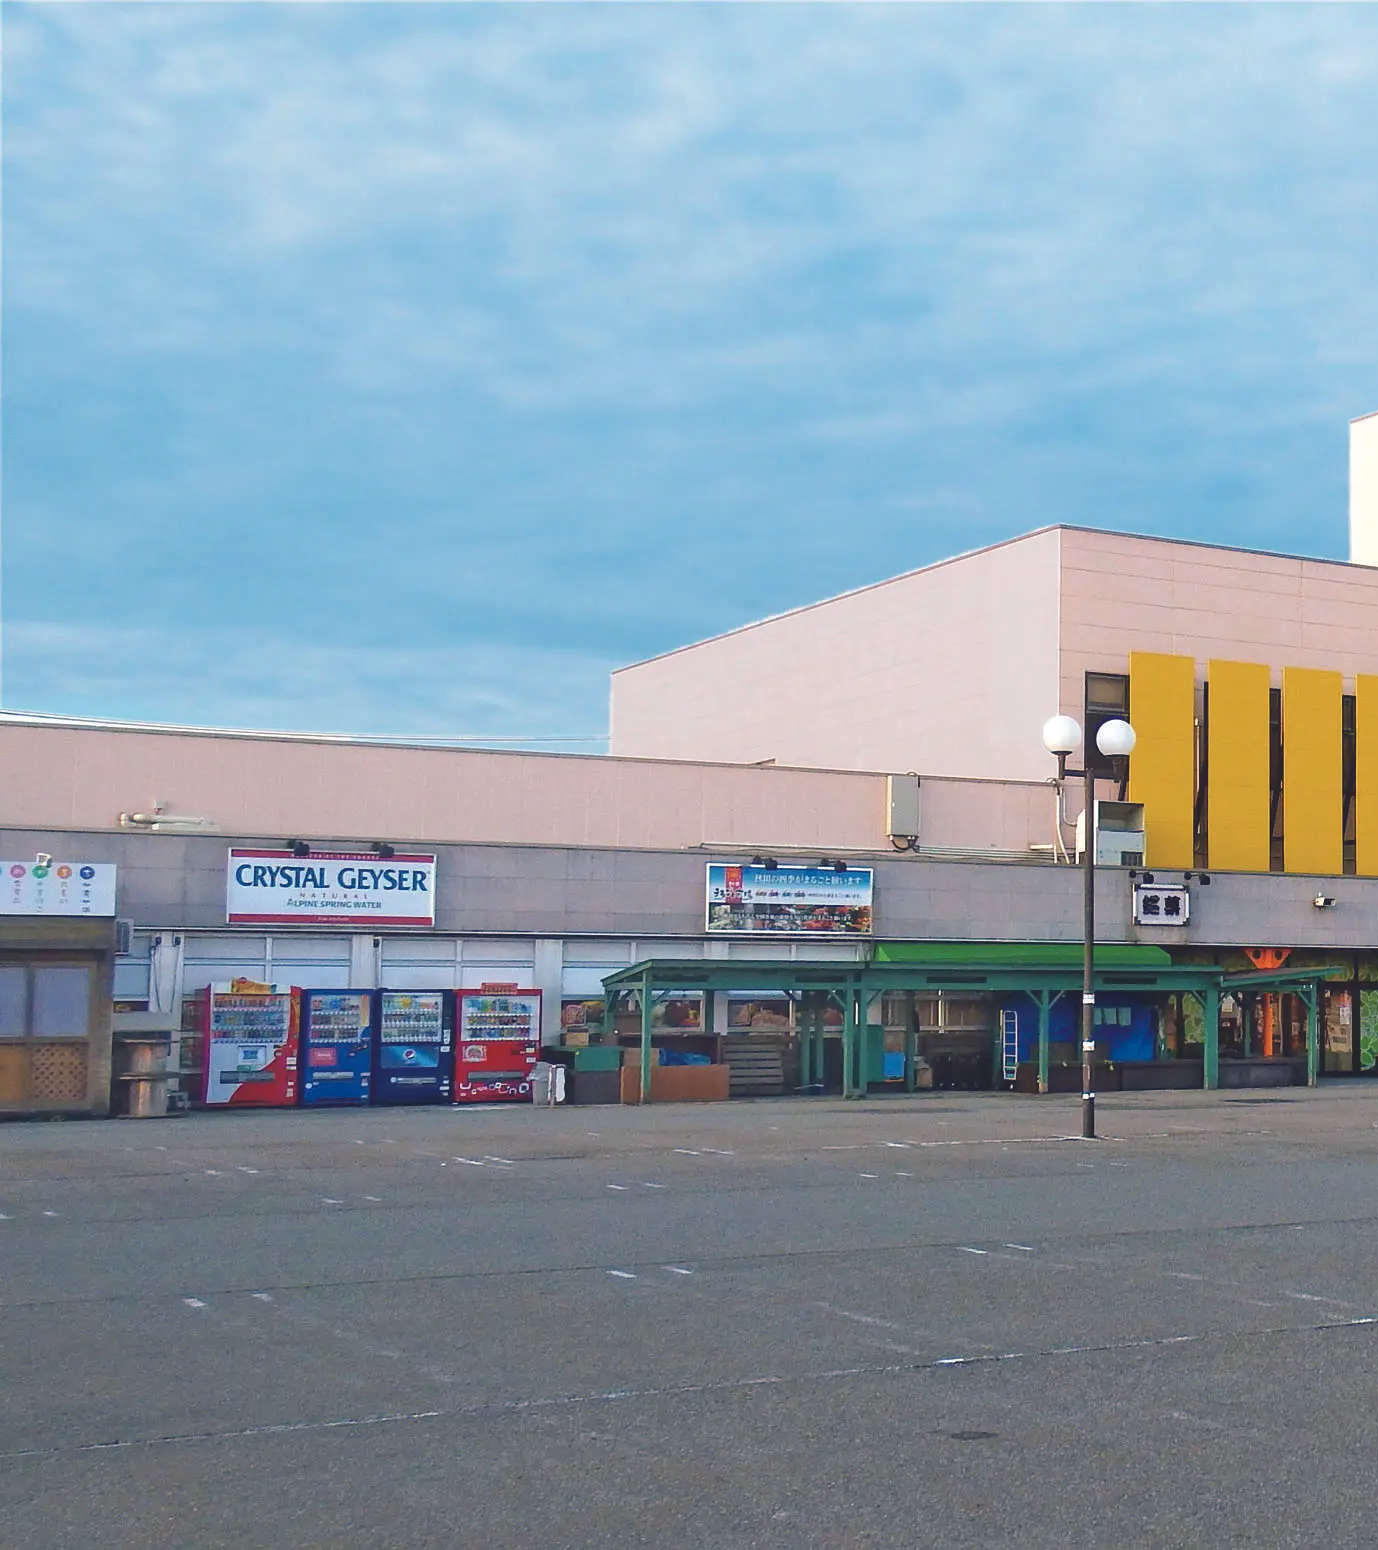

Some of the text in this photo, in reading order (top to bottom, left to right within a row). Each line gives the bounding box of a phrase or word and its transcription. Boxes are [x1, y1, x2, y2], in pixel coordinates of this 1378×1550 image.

[235, 863, 428, 891] CRYSTAL GEYSER
[299, 892, 369, 900] NATURAL
[286, 898, 382, 909] ALPINE SPRING WATER
